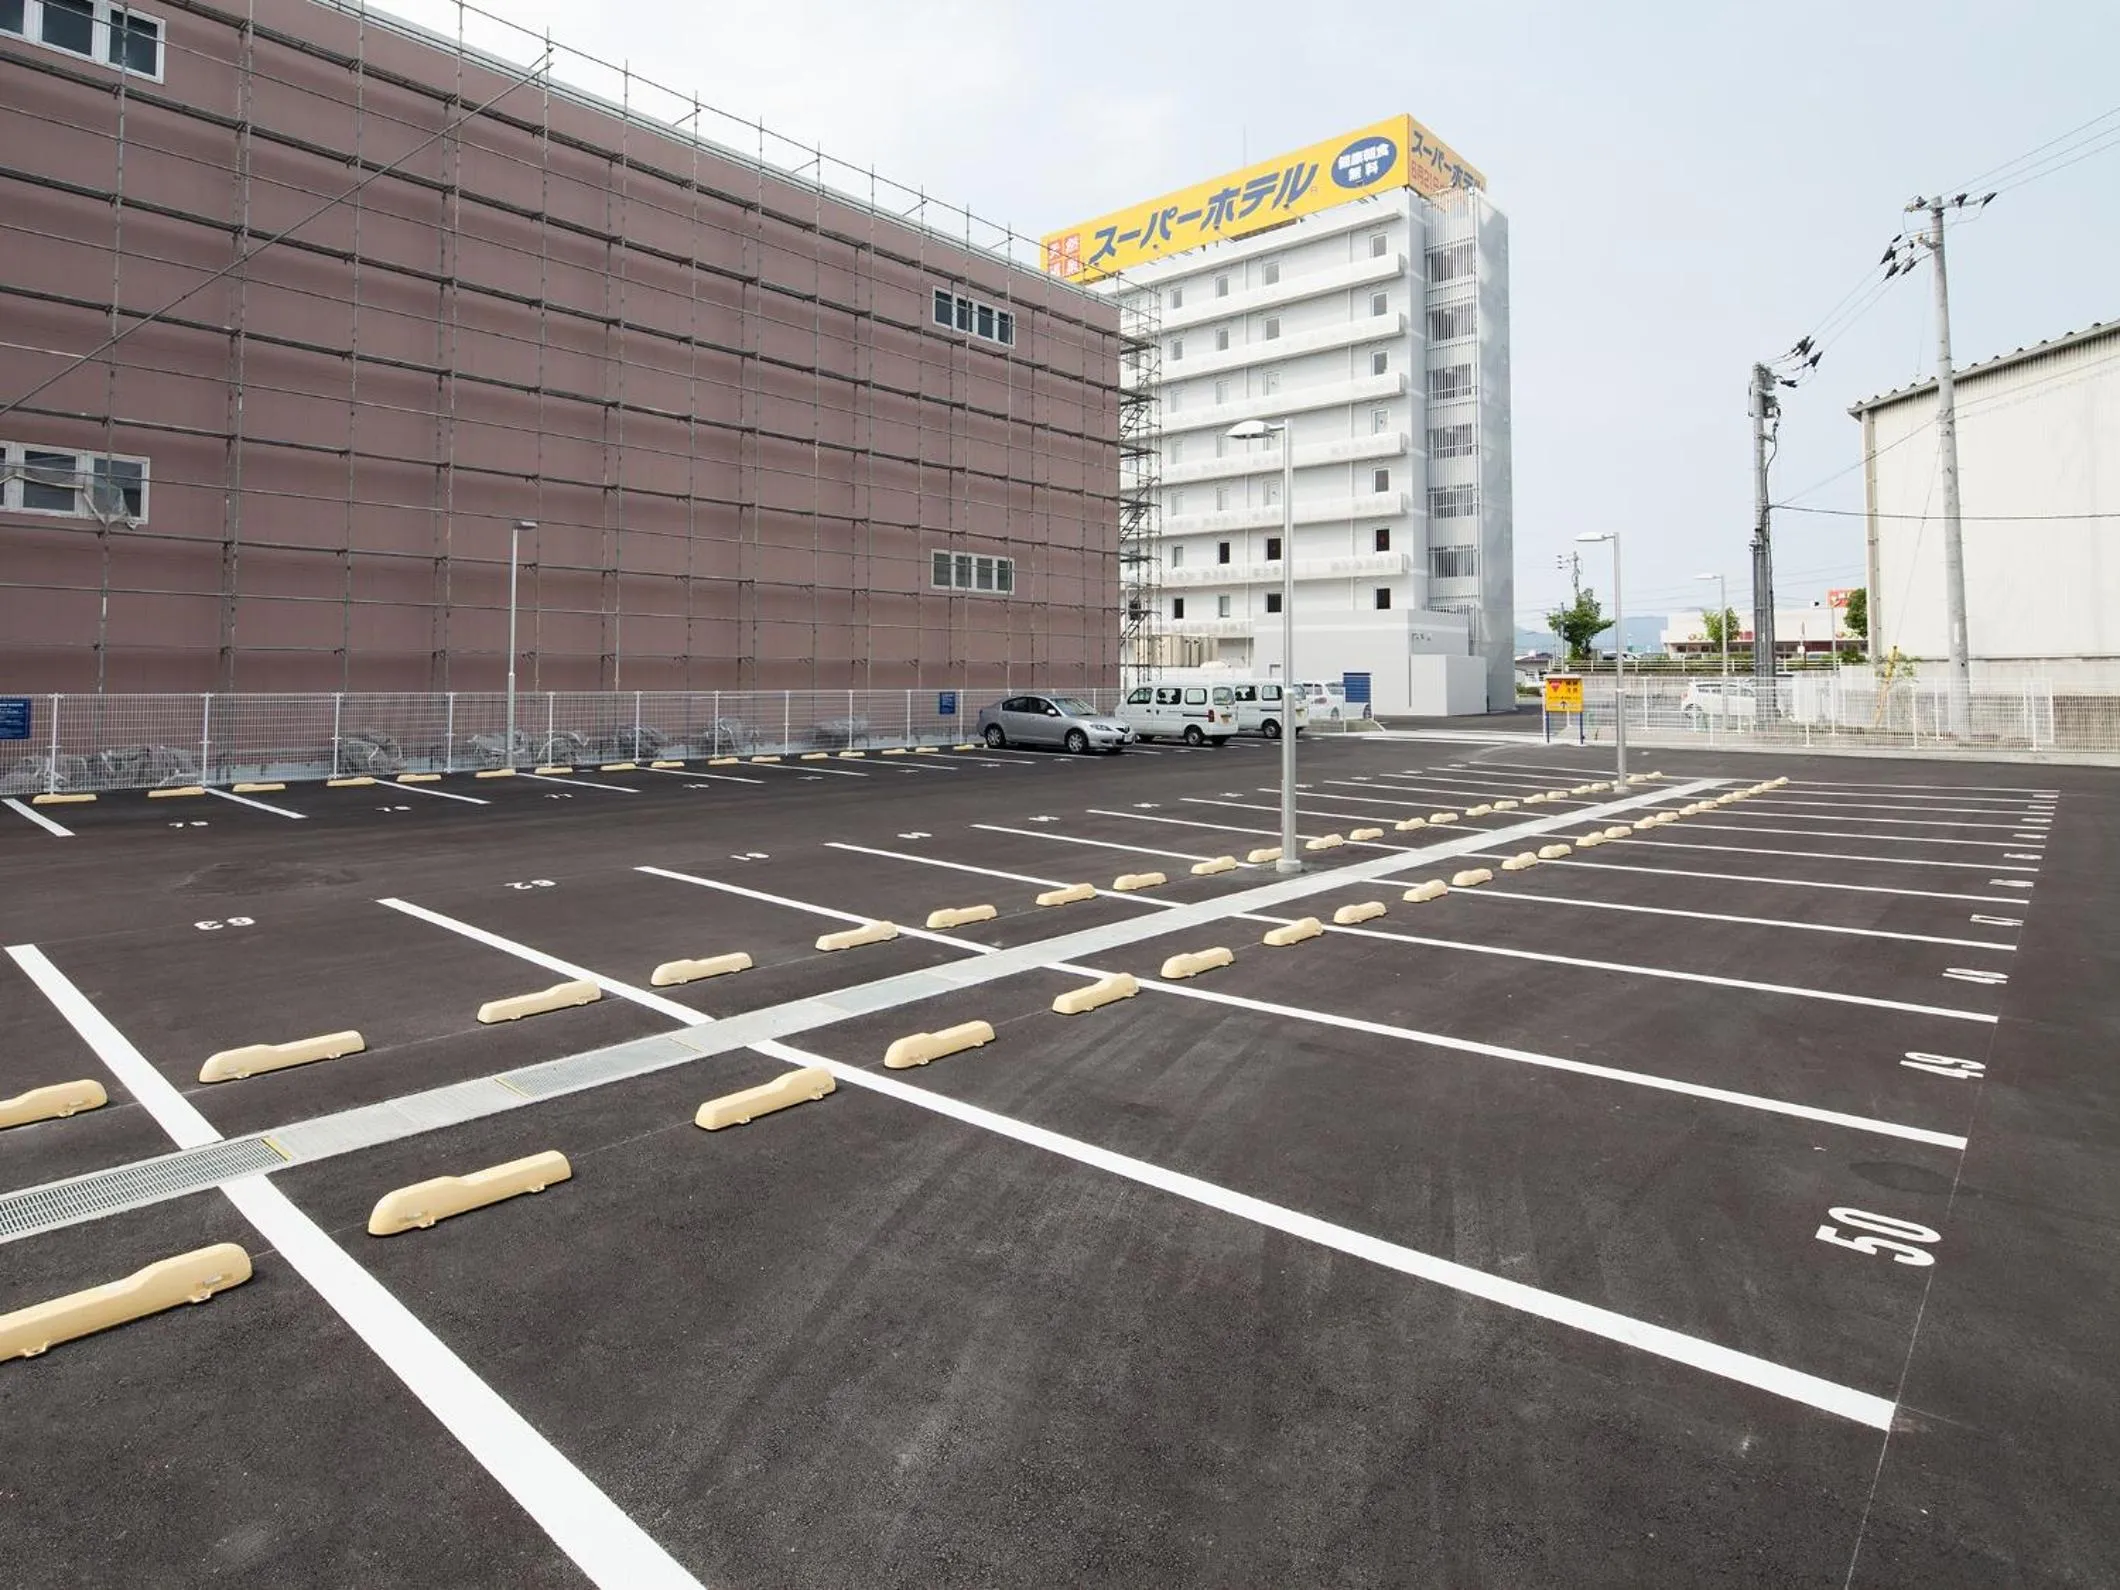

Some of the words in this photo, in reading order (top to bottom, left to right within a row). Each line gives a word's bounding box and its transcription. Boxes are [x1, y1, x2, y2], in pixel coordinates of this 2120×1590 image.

[1089, 162, 1319, 265] スーパーホテル
[1899, 1051, 1987, 1080] 49
[1815, 1206, 1942, 1267] 50
